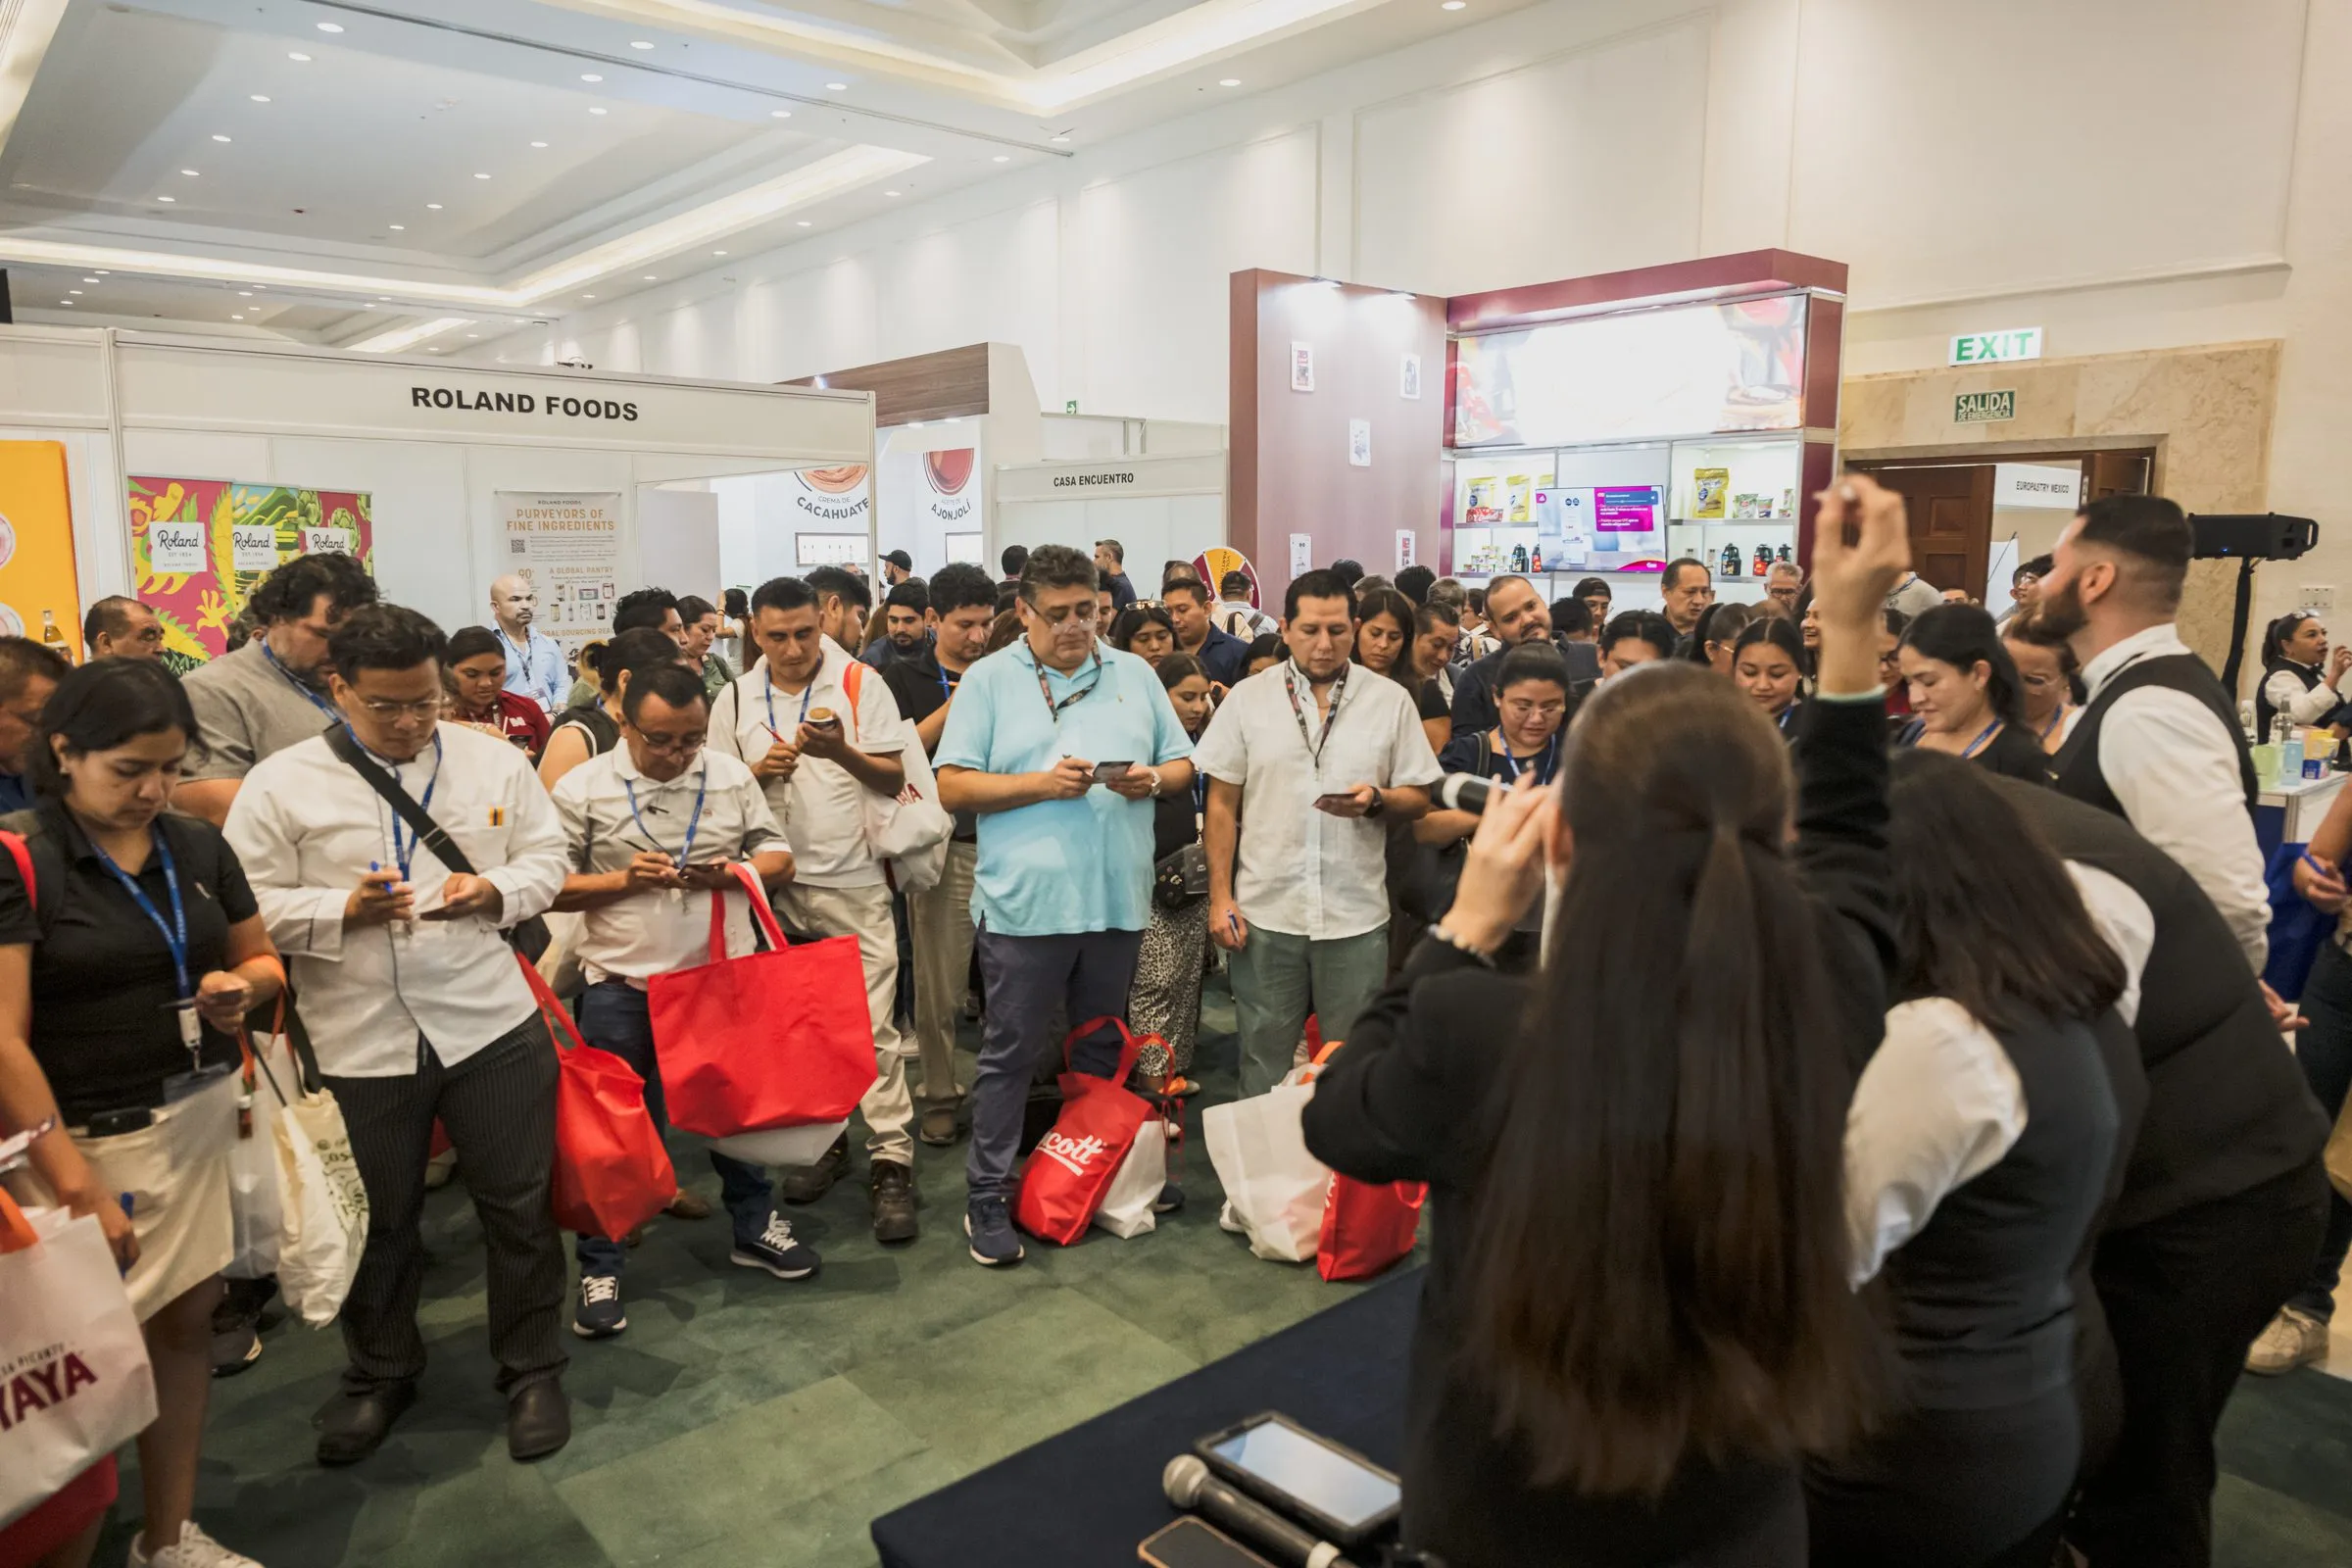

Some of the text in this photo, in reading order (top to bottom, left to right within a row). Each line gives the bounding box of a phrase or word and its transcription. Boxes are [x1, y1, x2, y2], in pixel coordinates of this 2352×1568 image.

[1956, 331, 2034, 361] EXIT
[412, 387, 638, 421] ROLAND FOODS
[1958, 393, 2011, 413] SALIDA
[1054, 472, 1134, 487] CASA ENCUENTRO
[2017, 481, 2070, 493] EUROPASTRY MEXICO
[797, 496, 869, 519] CACAHUATE
[817, 495, 841, 504] CREMA
[931, 498, 971, 520] AJONJOLÍ
[516, 509, 604, 518] PURVEYORS OF
[507, 520, 614, 531] FINE INGREDIENTS
[157, 529, 199, 550] Roland
[232, 531, 270, 550] Roland
[312, 533, 345, 550] Roland
